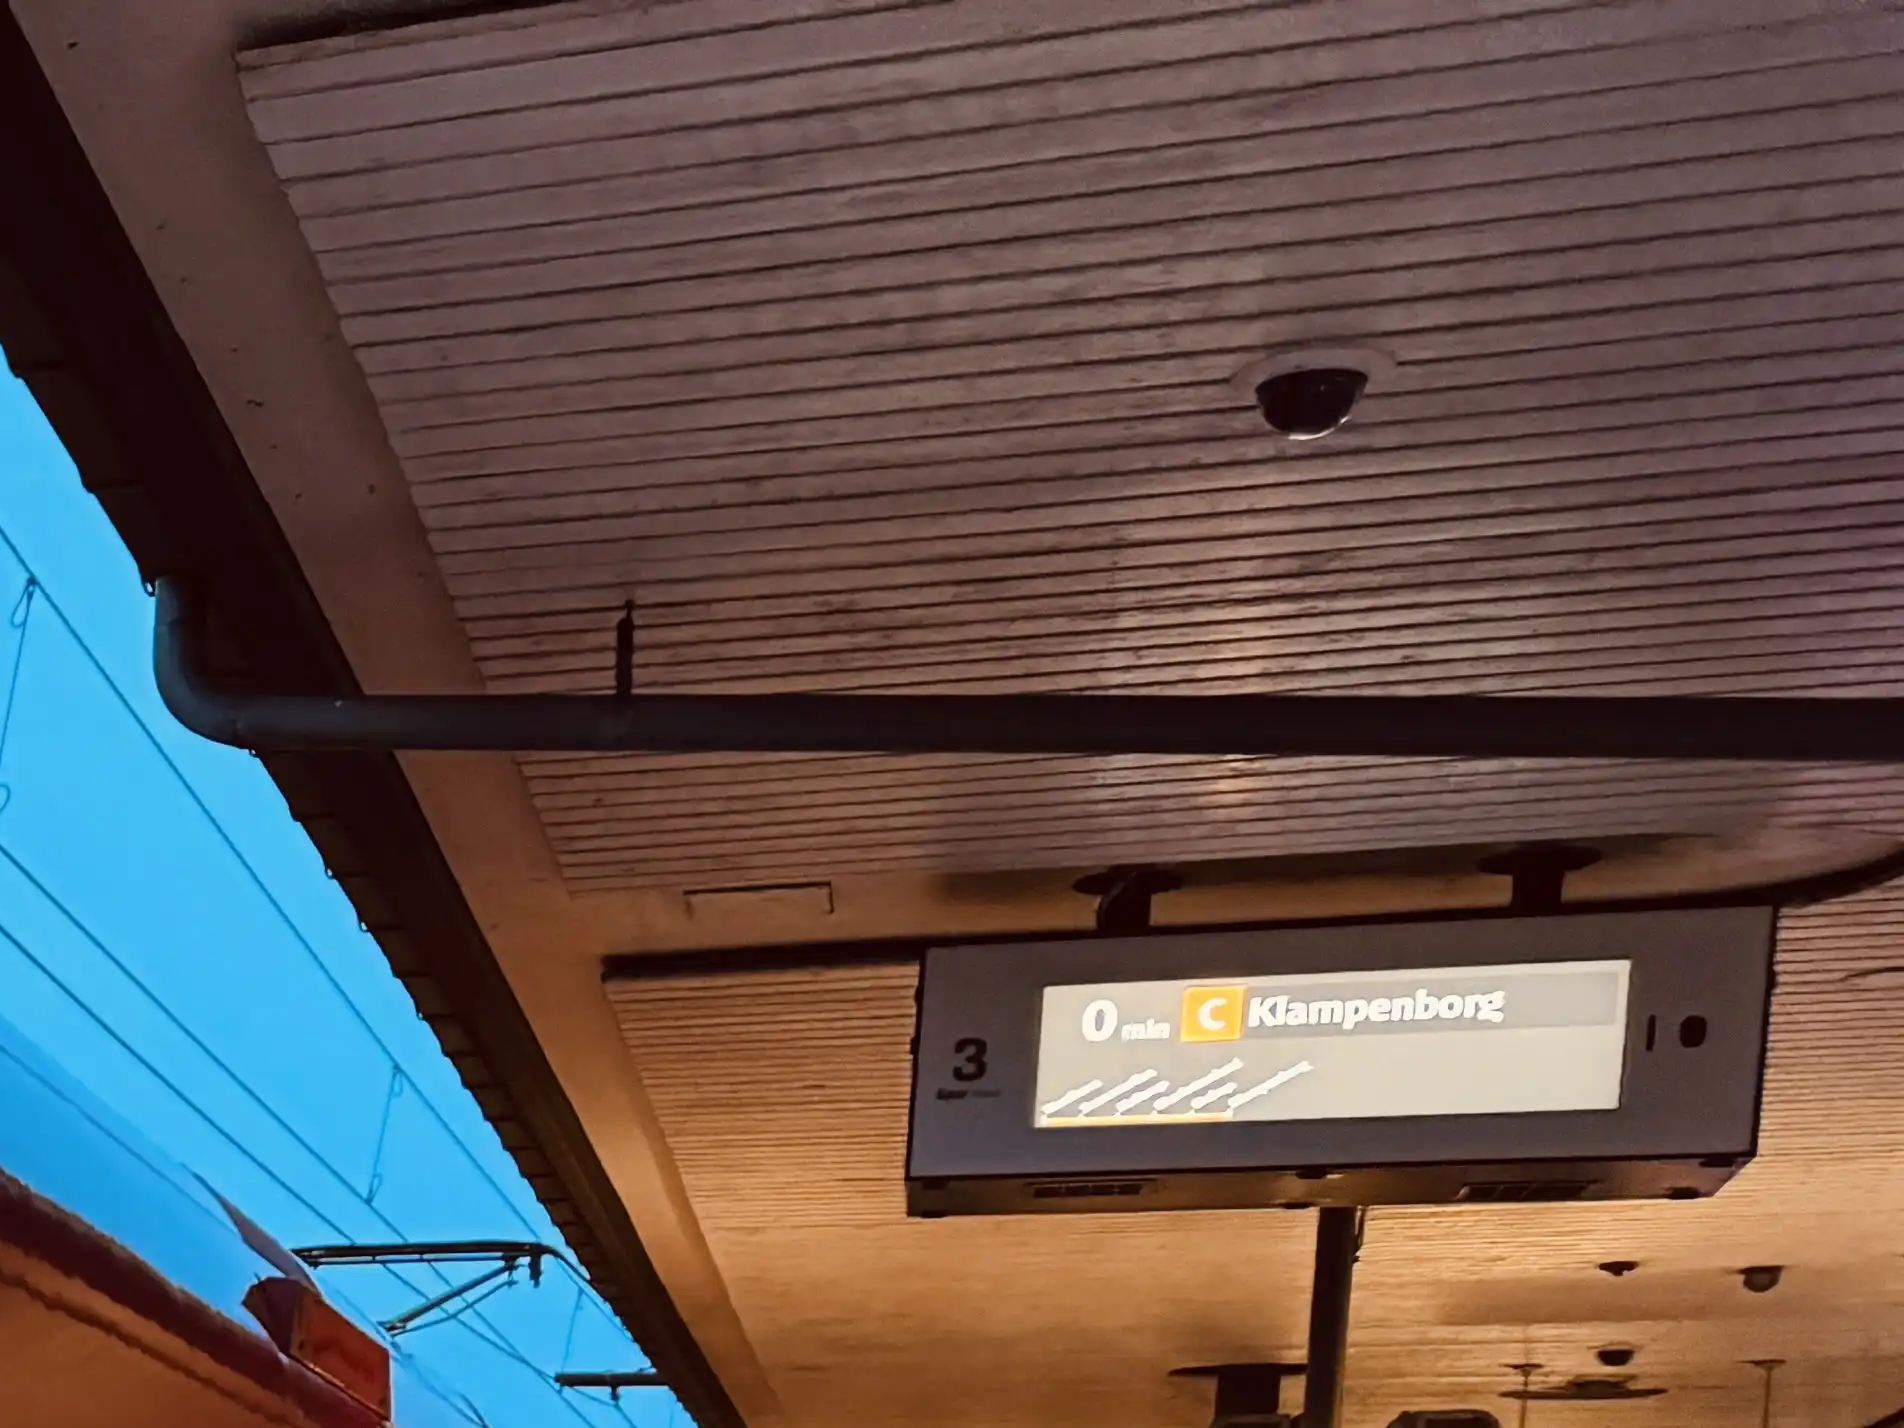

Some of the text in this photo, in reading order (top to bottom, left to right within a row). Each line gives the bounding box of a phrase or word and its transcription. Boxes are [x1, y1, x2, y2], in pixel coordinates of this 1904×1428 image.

[1082, 988, 1506, 1042] 0 min C Klampenborg
[953, 1037, 987, 1082] 3
